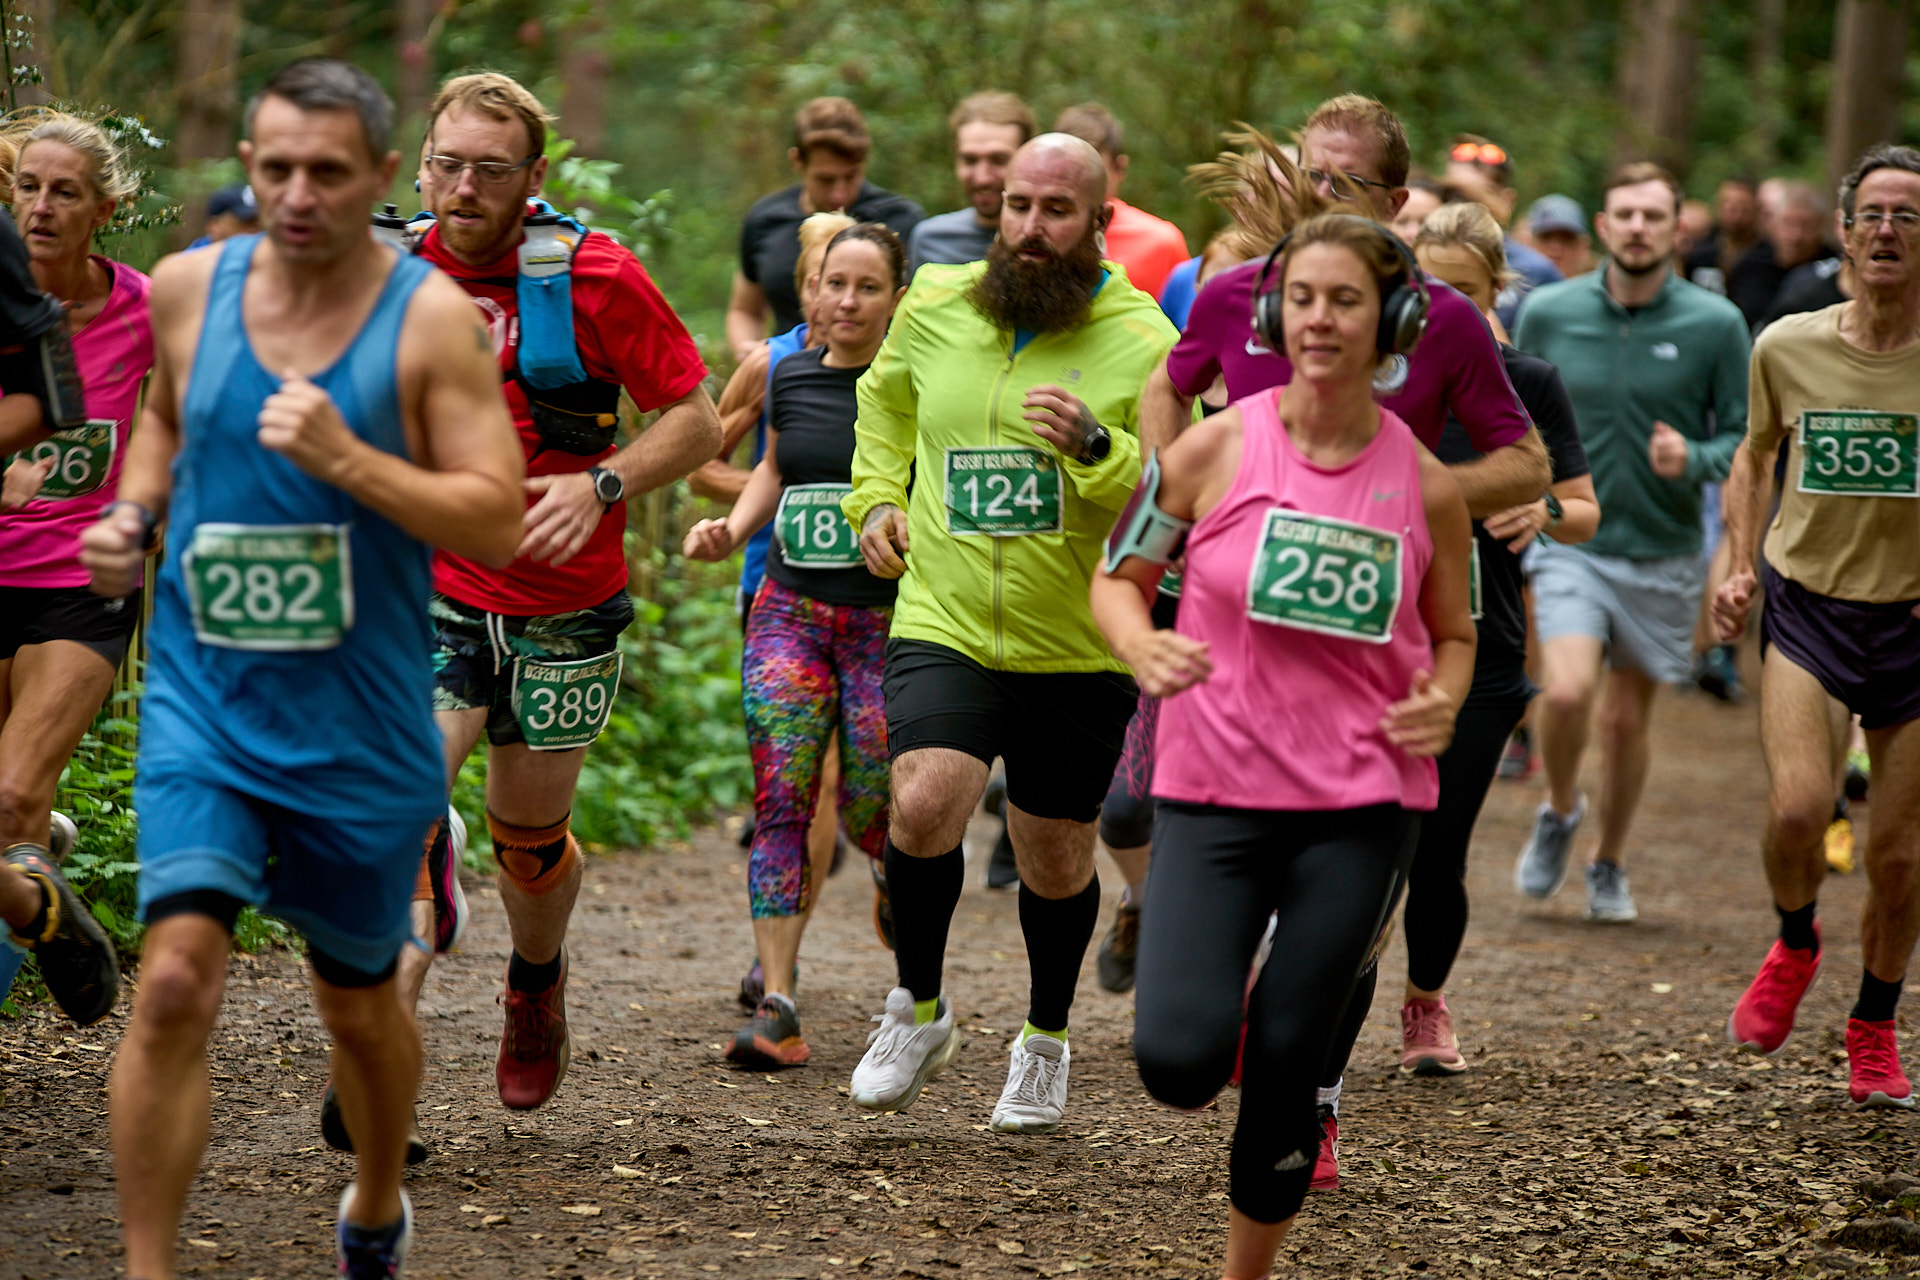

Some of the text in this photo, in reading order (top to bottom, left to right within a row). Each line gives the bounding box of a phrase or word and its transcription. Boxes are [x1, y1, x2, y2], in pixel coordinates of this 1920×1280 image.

[12, 441, 93, 485] 96
[1815, 436, 1902, 477] 353
[962, 473, 1044, 517] 124
[205, 563, 324, 622] 282
[1268, 547, 1380, 614] 258
[527, 682, 607, 730] 389
